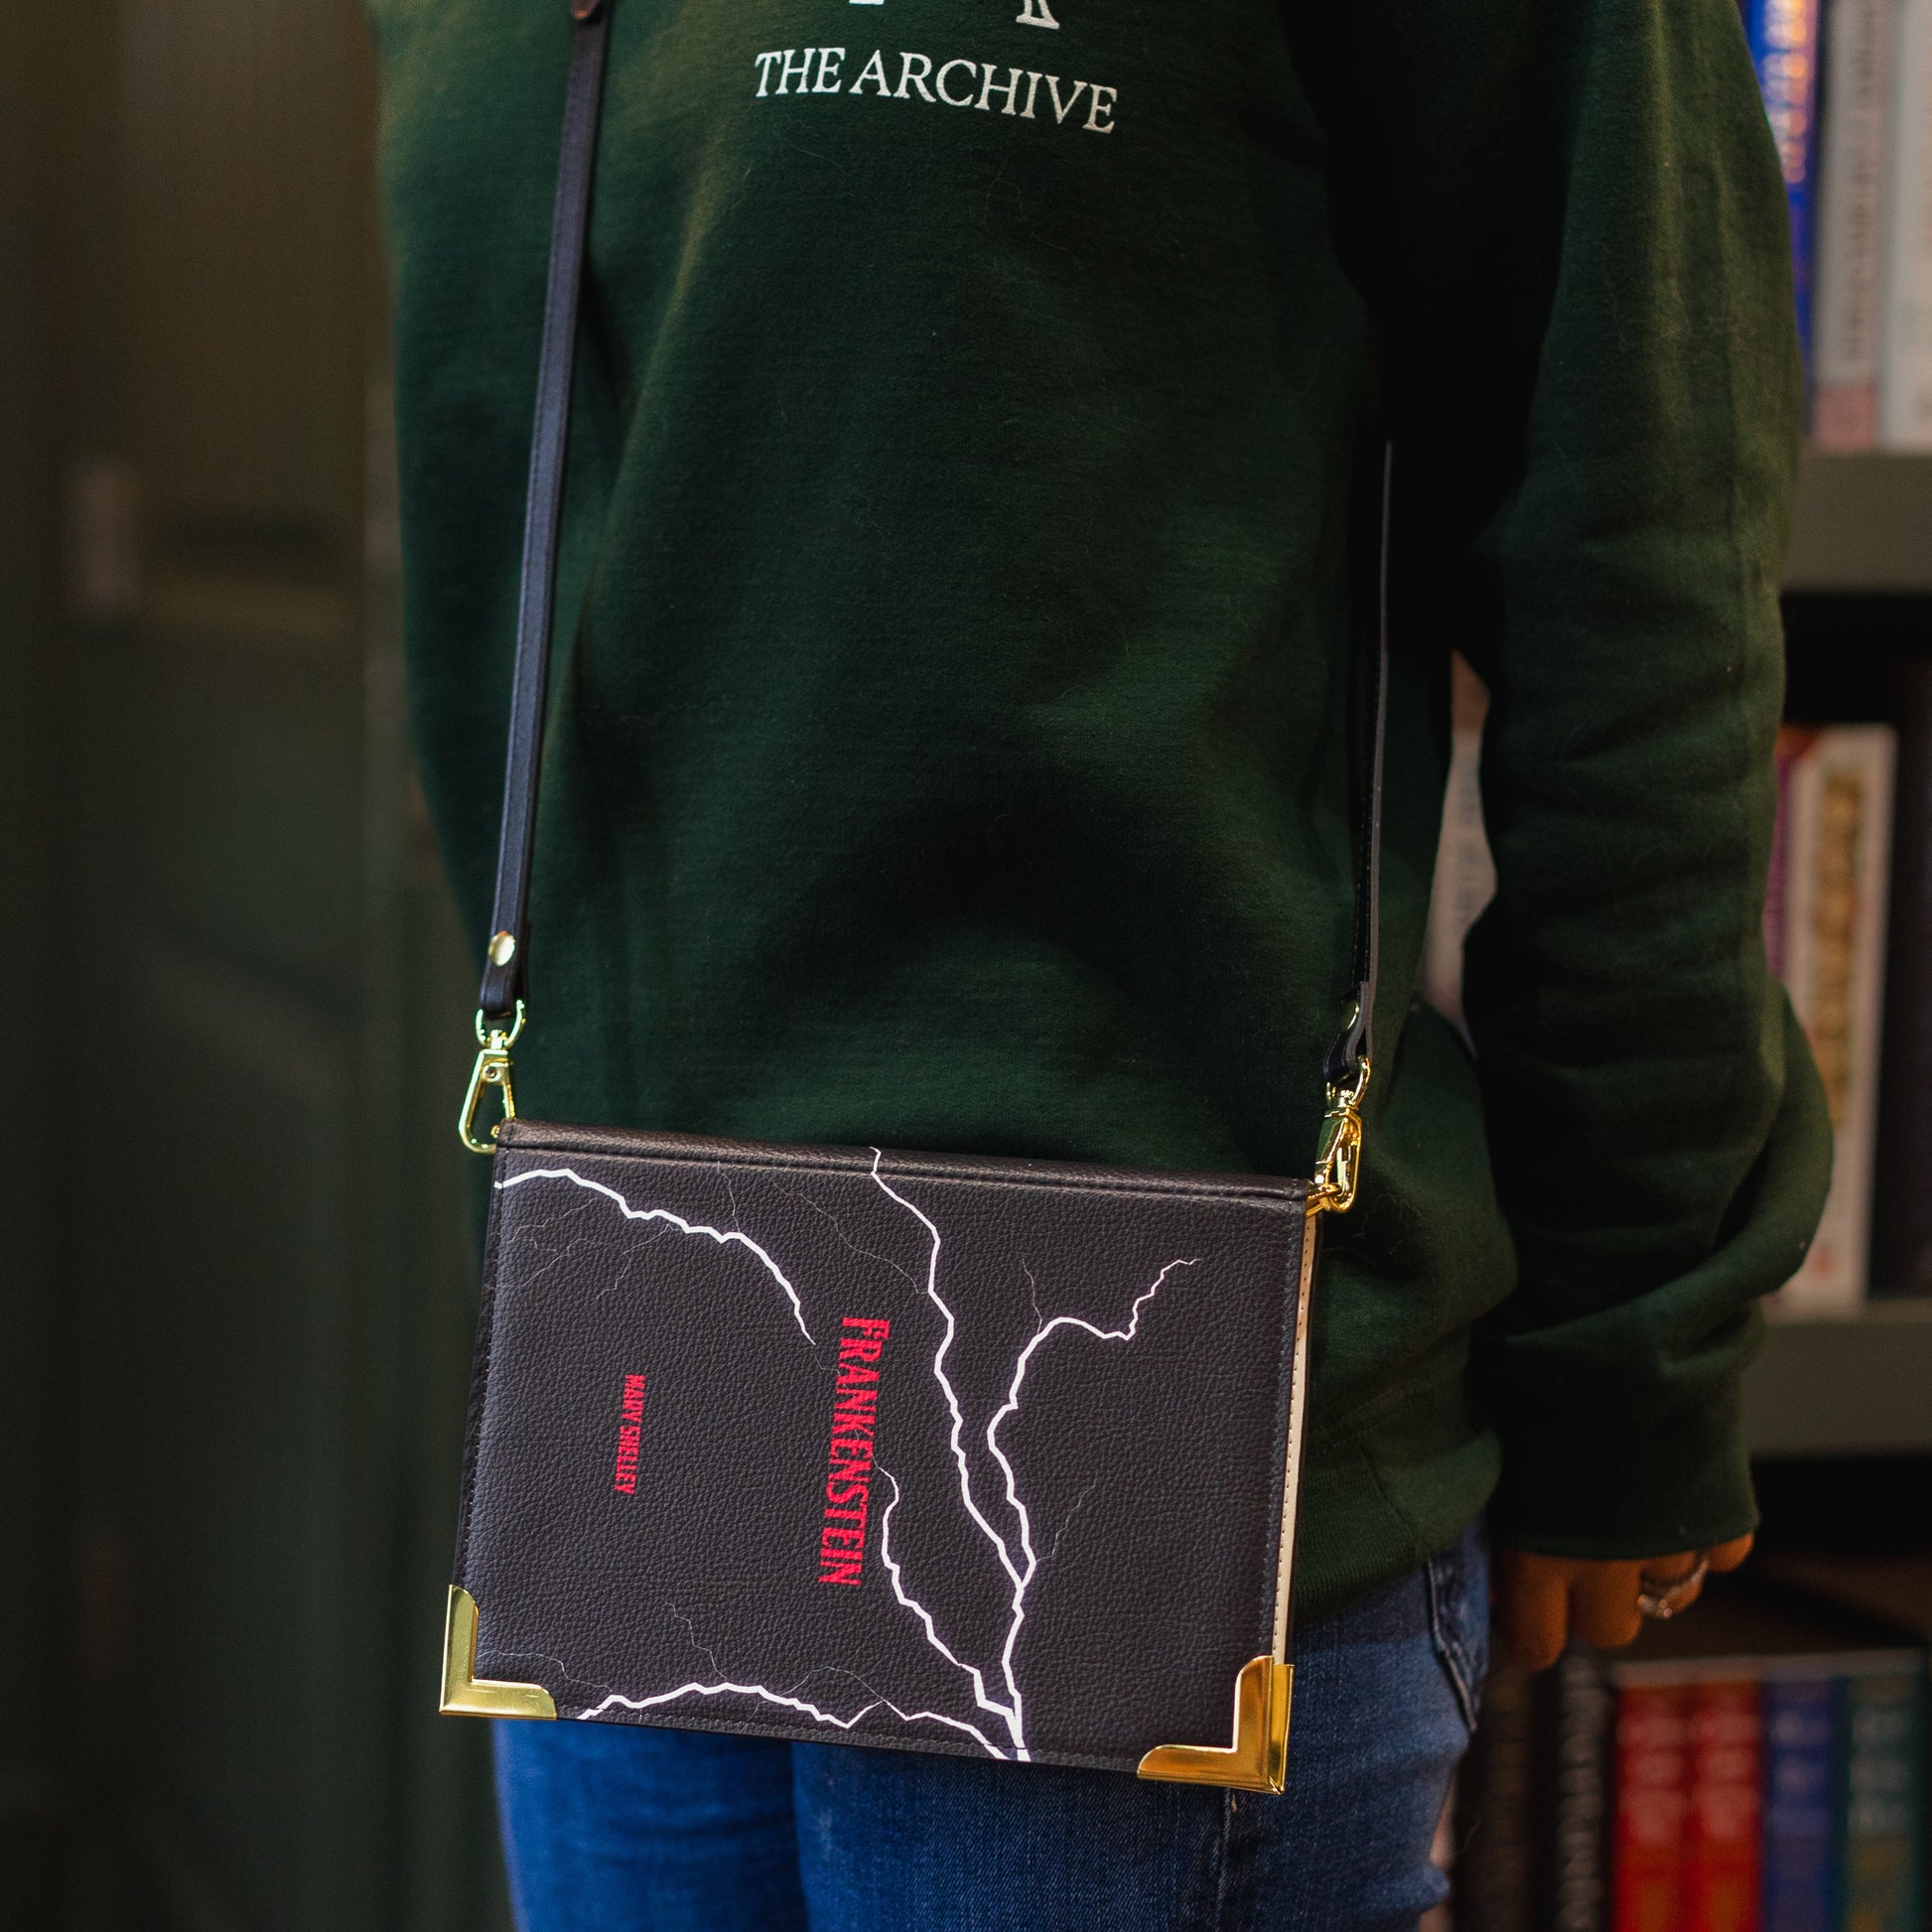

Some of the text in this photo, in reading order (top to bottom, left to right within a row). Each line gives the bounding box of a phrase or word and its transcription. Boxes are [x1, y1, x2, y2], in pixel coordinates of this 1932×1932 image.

[755, 47, 1118, 134] THE ARCHIVE
[614, 1373, 646, 1495] MARY SHELLEY
[817, 1316, 891, 1587] FRANKENSTEIN
